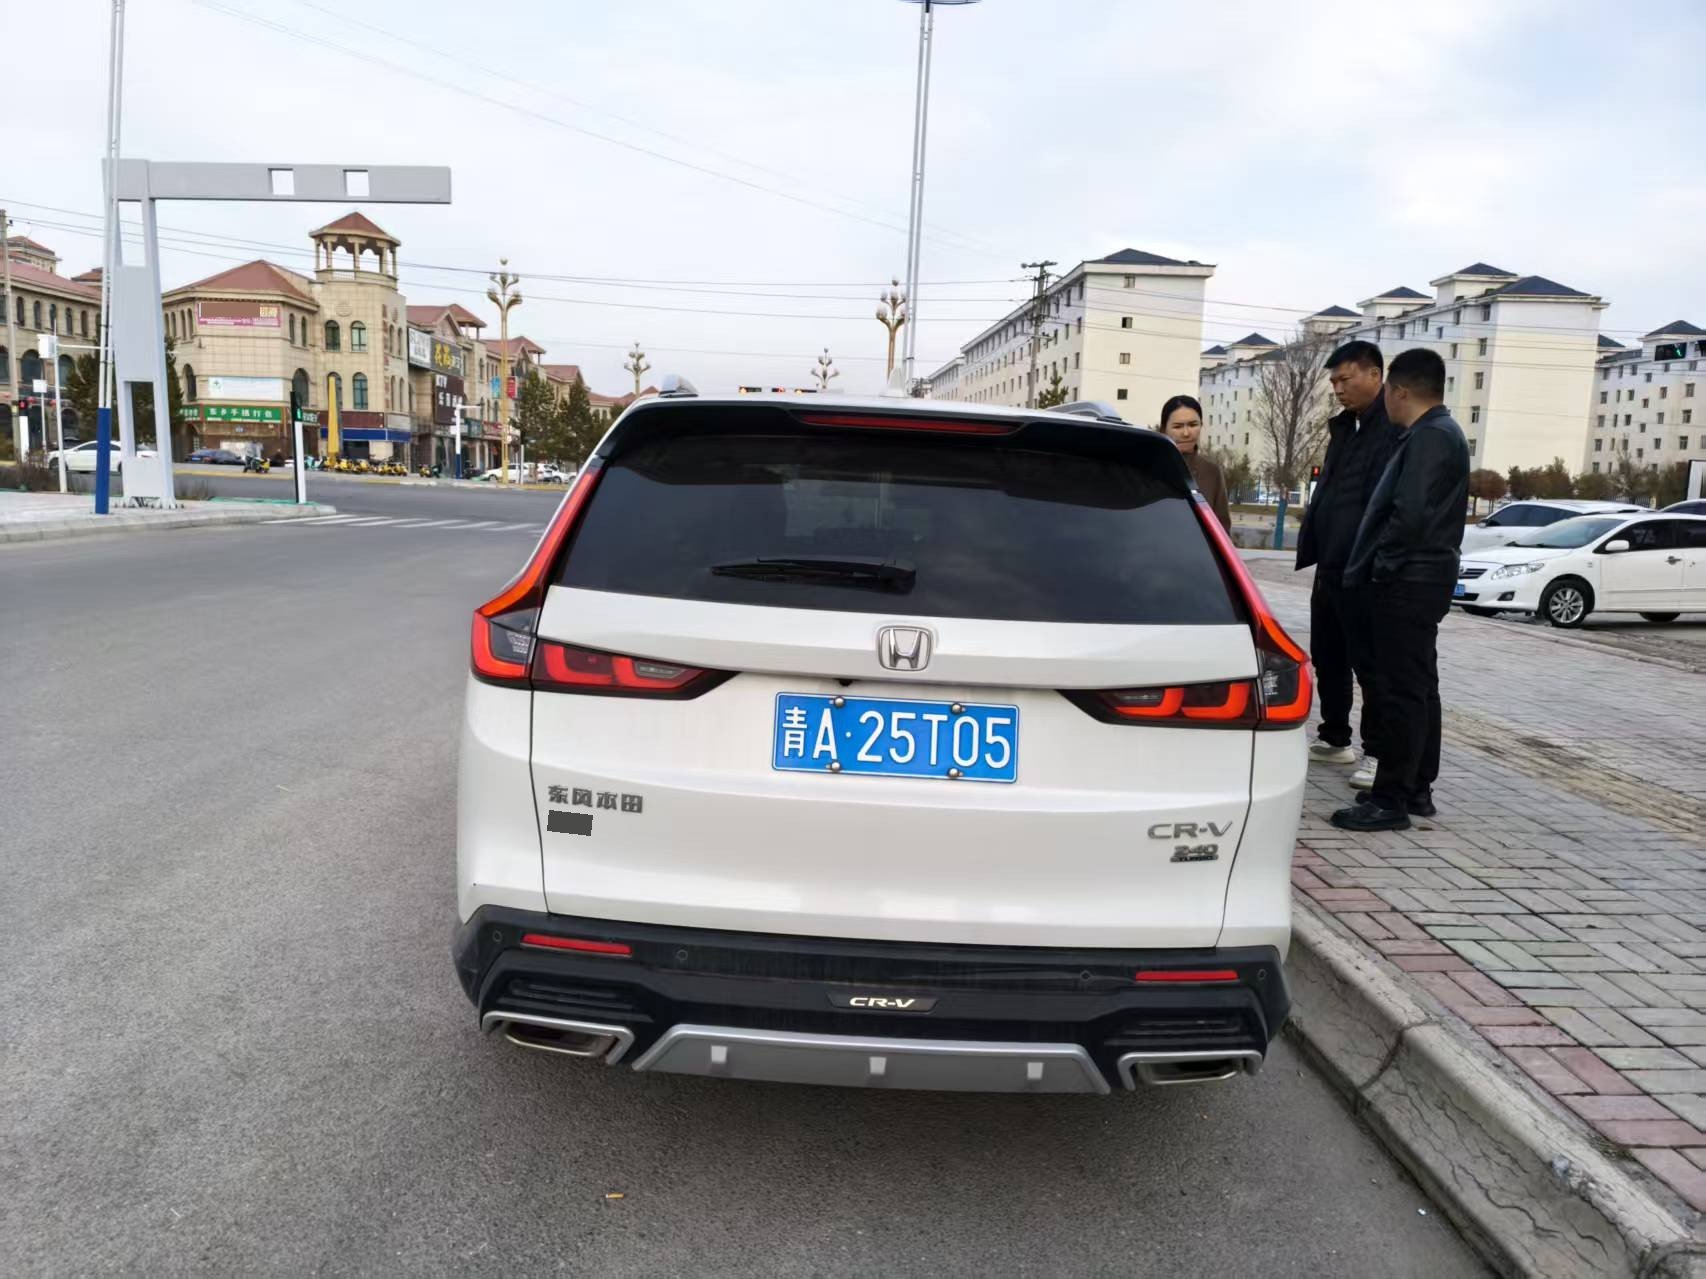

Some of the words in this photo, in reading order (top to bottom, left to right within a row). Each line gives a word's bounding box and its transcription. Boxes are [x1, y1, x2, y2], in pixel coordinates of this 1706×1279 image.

[782, 706, 1012, 769] 青A·25T05
[548, 785, 643, 814] 东风本田
[1147, 821, 1233, 840] CR-V
[849, 997, 915, 1008] CR-V
